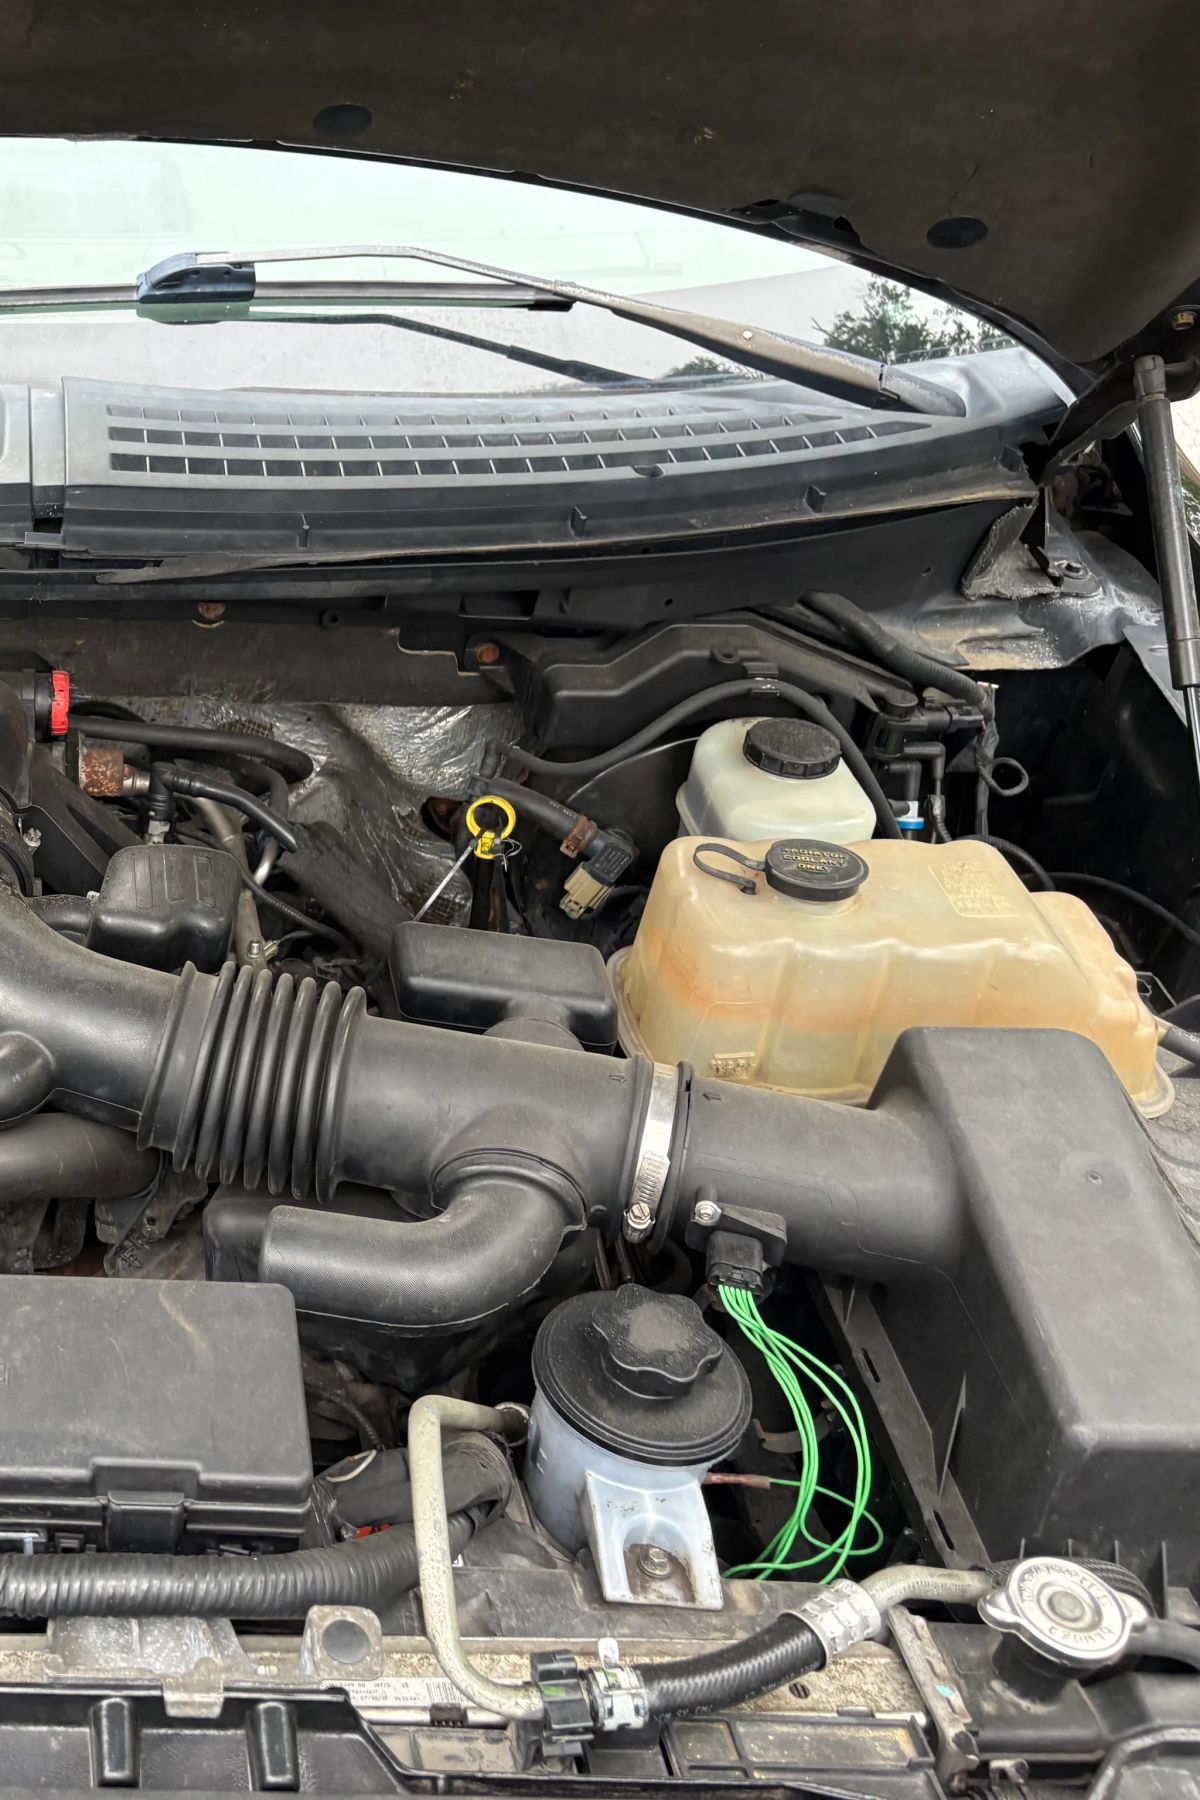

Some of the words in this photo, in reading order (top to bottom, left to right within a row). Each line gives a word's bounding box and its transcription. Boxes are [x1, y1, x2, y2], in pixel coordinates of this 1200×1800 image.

[780, 848, 849, 860] RADIATOR
[783, 854, 847, 867] COOLANT
[797, 863, 832, 873] ONLY
